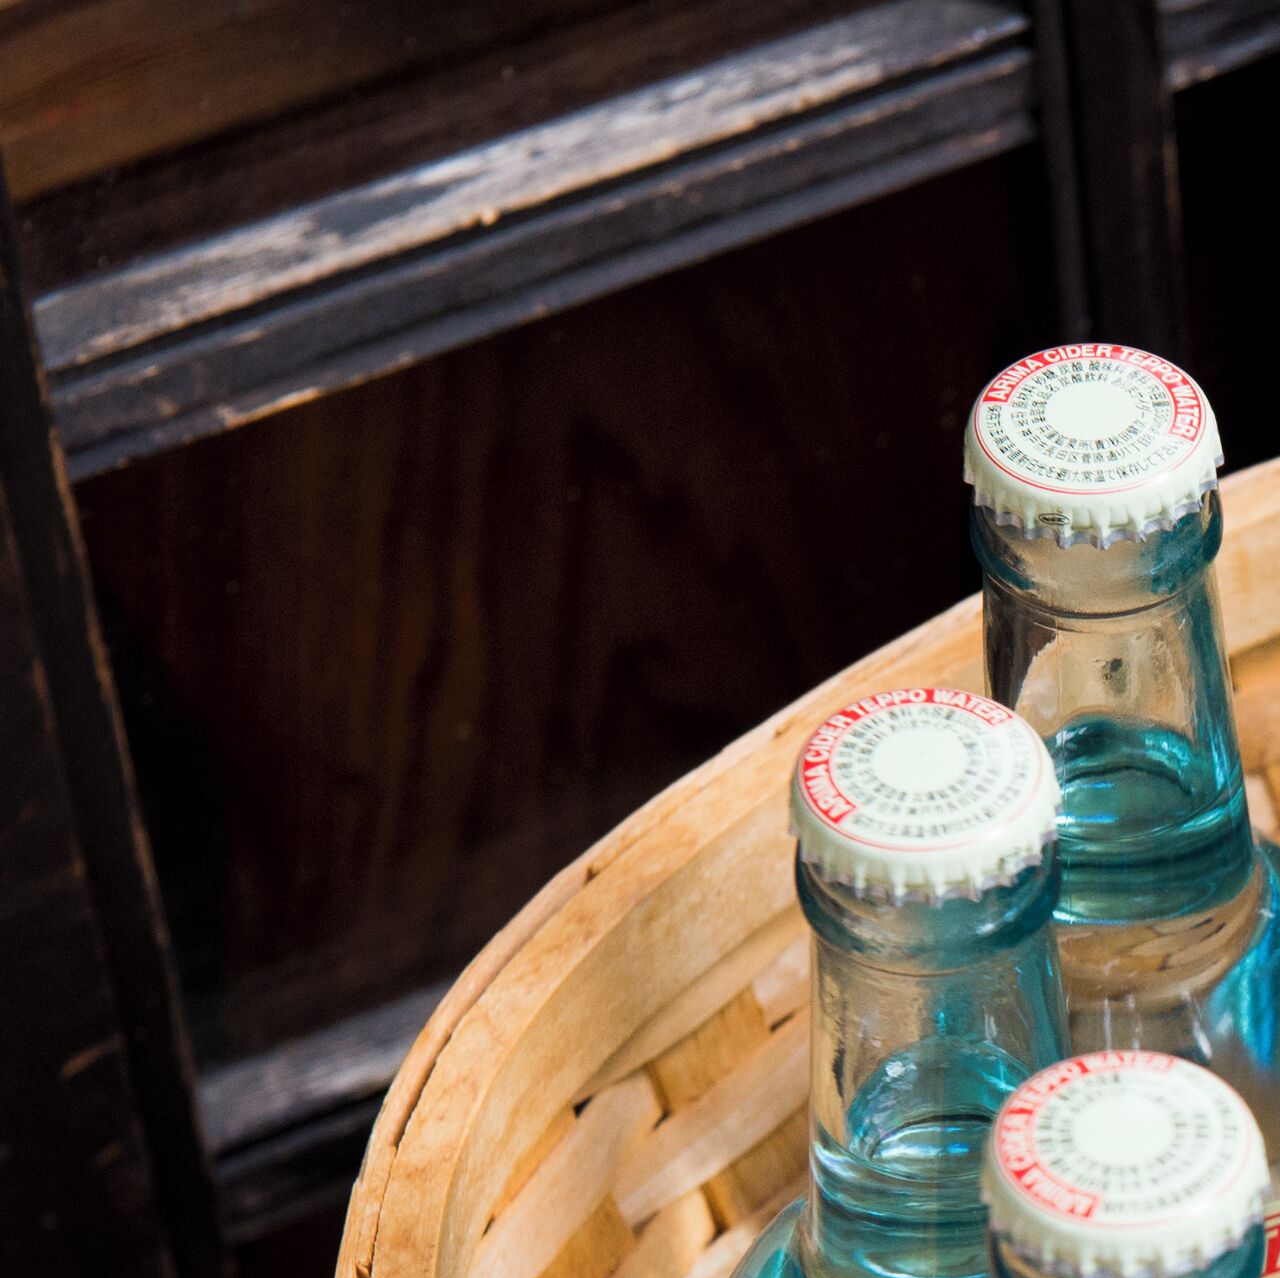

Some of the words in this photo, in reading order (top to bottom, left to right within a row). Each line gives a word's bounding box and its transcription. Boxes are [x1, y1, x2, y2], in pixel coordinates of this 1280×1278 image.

[988, 358, 1044, 401] ARIMA
[1044, 345, 1113, 363] CIDER
[1120, 348, 1181, 384] TEPPO
[1169, 386, 1200, 440] WATER
[851, 689, 927, 716] TEPPO
[933, 688, 1010, 726] WATER
[805, 714, 851, 762] CIDER
[804, 764, 852, 821] ARIMA
